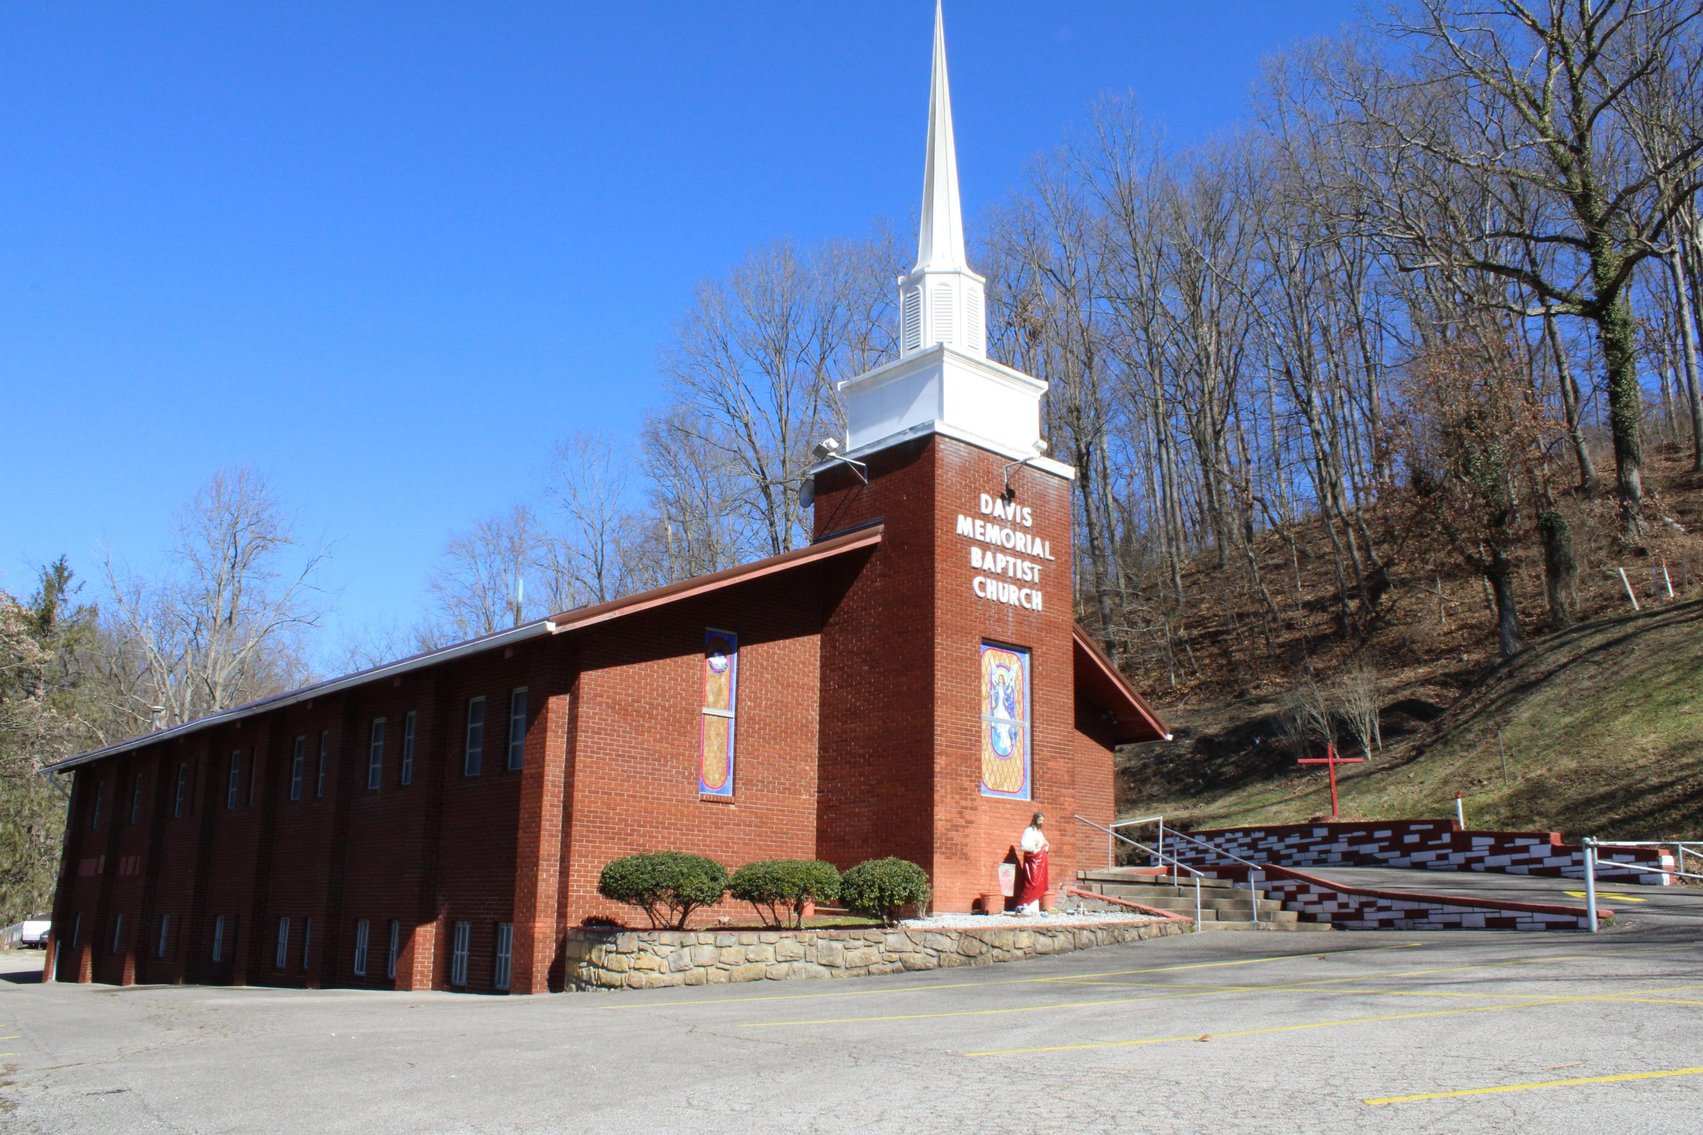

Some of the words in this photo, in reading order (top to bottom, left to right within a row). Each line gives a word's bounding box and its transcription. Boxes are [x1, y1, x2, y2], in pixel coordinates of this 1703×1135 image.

[980, 493, 1032, 527] DAVIS
[957, 514, 1055, 560] MEMORIAL
[970, 547, 1042, 583] BAPTIST
[972, 577, 1042, 611] CHURCH
